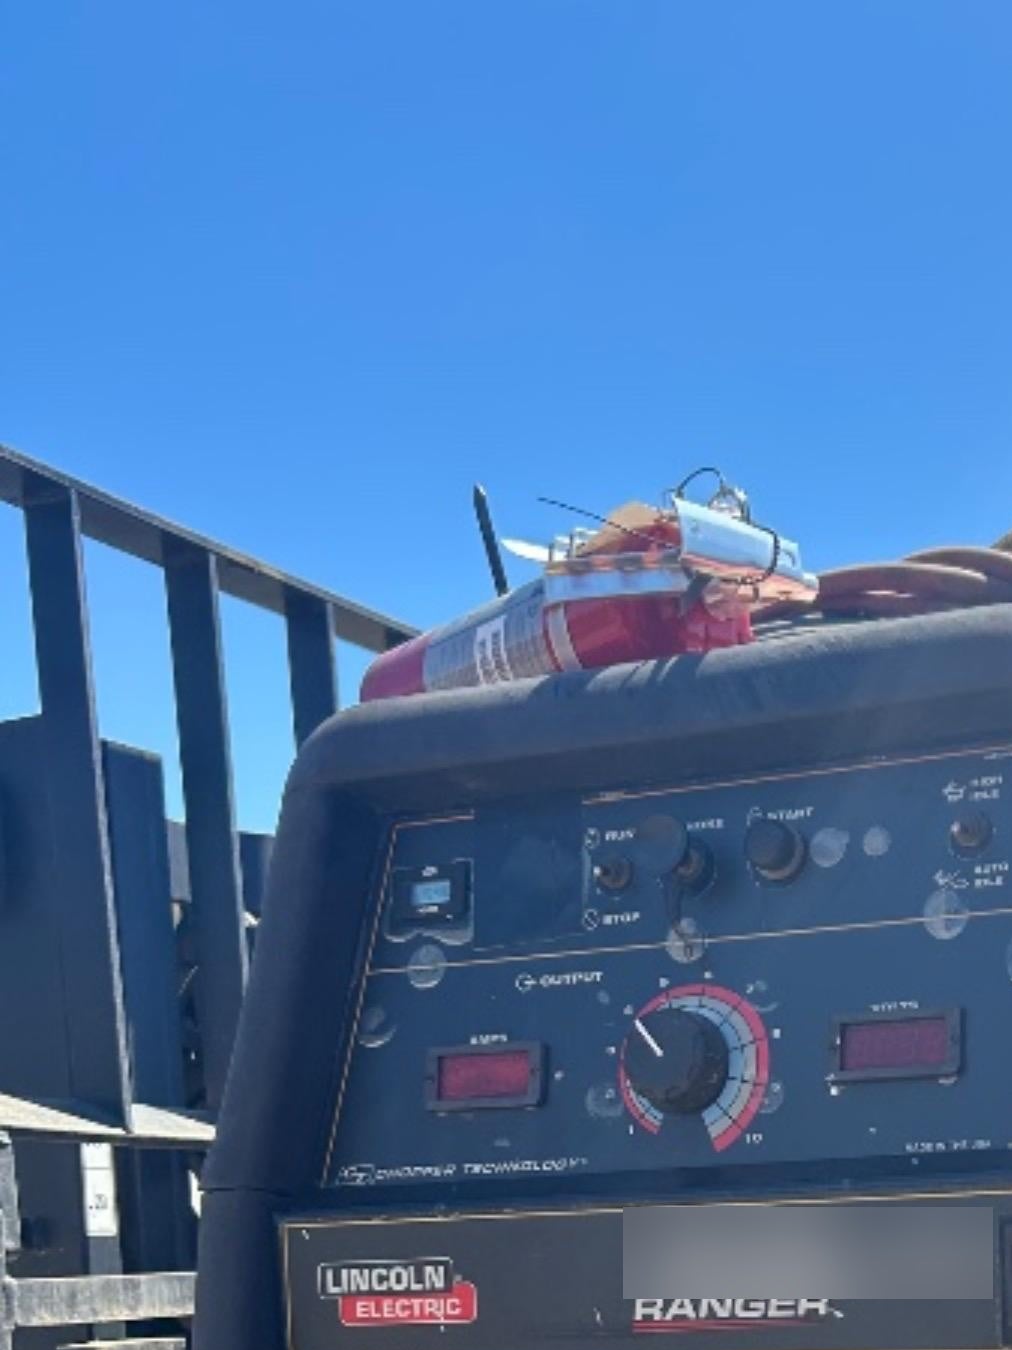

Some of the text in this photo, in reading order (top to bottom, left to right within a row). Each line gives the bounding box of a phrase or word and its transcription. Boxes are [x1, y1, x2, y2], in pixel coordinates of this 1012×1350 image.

[539, 970, 604, 988] OUTPUT
[325, 1264, 445, 1294] LINCOLN
[355, 1297, 462, 1319] ELECTRIC
[633, 1298, 830, 1321] RANGER
